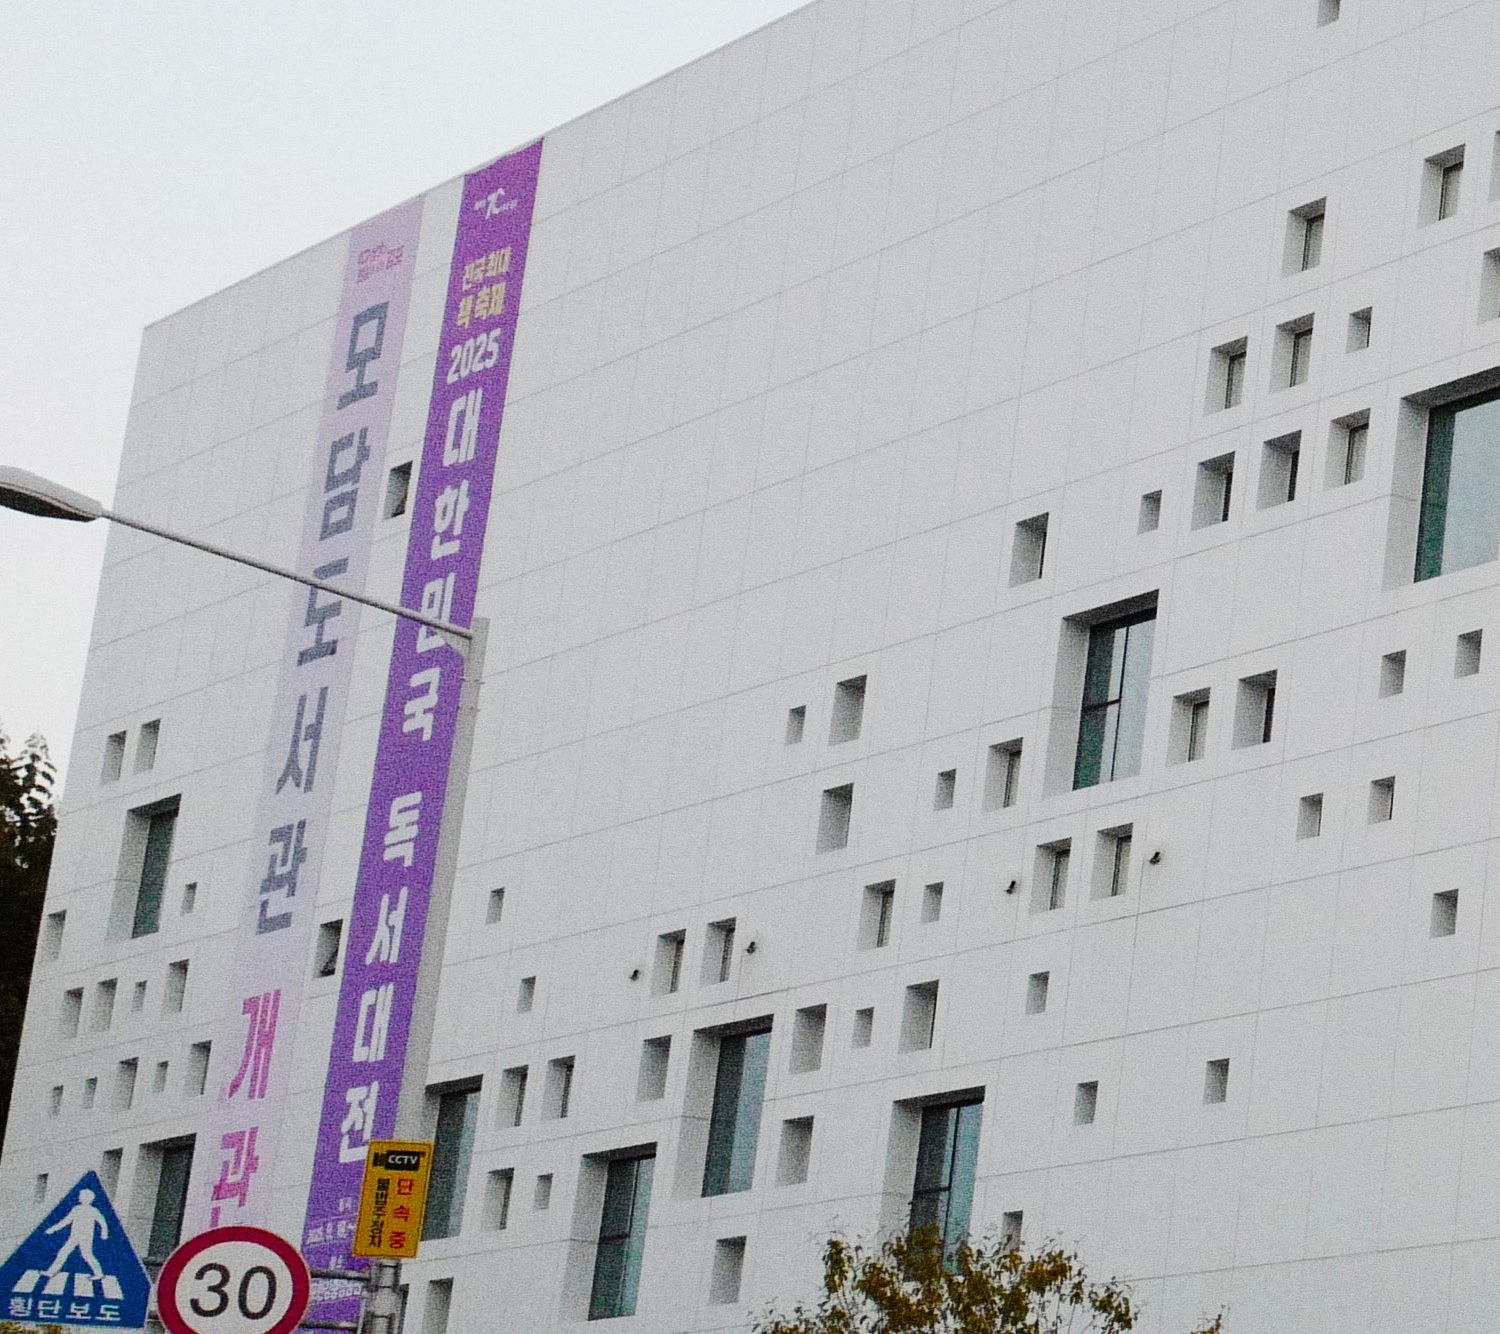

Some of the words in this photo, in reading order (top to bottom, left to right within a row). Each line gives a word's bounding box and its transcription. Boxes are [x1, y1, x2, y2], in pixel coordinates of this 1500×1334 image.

[446, 328, 502, 384] 2025
[403, 388, 482, 742] 대한민국
[255, 301, 389, 935] 모담도서관
[340, 791, 422, 1163] 독서대전
[388, 1154, 418, 1165] CCTV
[8, 1298, 122, 1322] 횡단보도
[190, 1262, 278, 1320] 30
